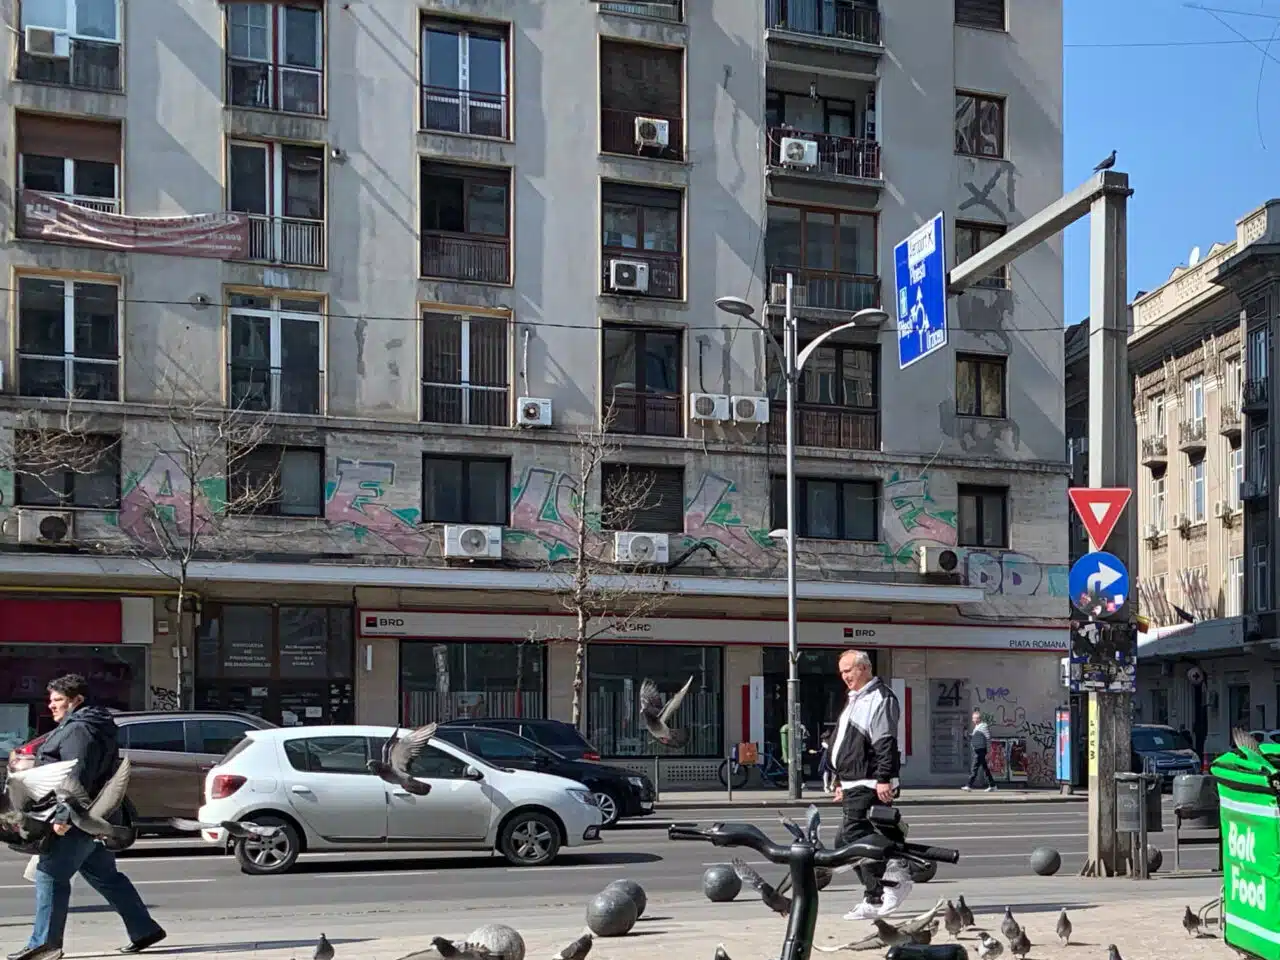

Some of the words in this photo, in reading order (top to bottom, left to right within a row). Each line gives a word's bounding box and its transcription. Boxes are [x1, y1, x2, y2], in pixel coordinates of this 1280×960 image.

[380, 618, 405, 627] BRD
[855, 629, 876, 637] BRD
[1009, 639, 1031, 648] PIATA
[1032, 640, 1067, 649] ROMANA
[1228, 821, 1256, 864] Bolt
[1231, 866, 1266, 912] Food
